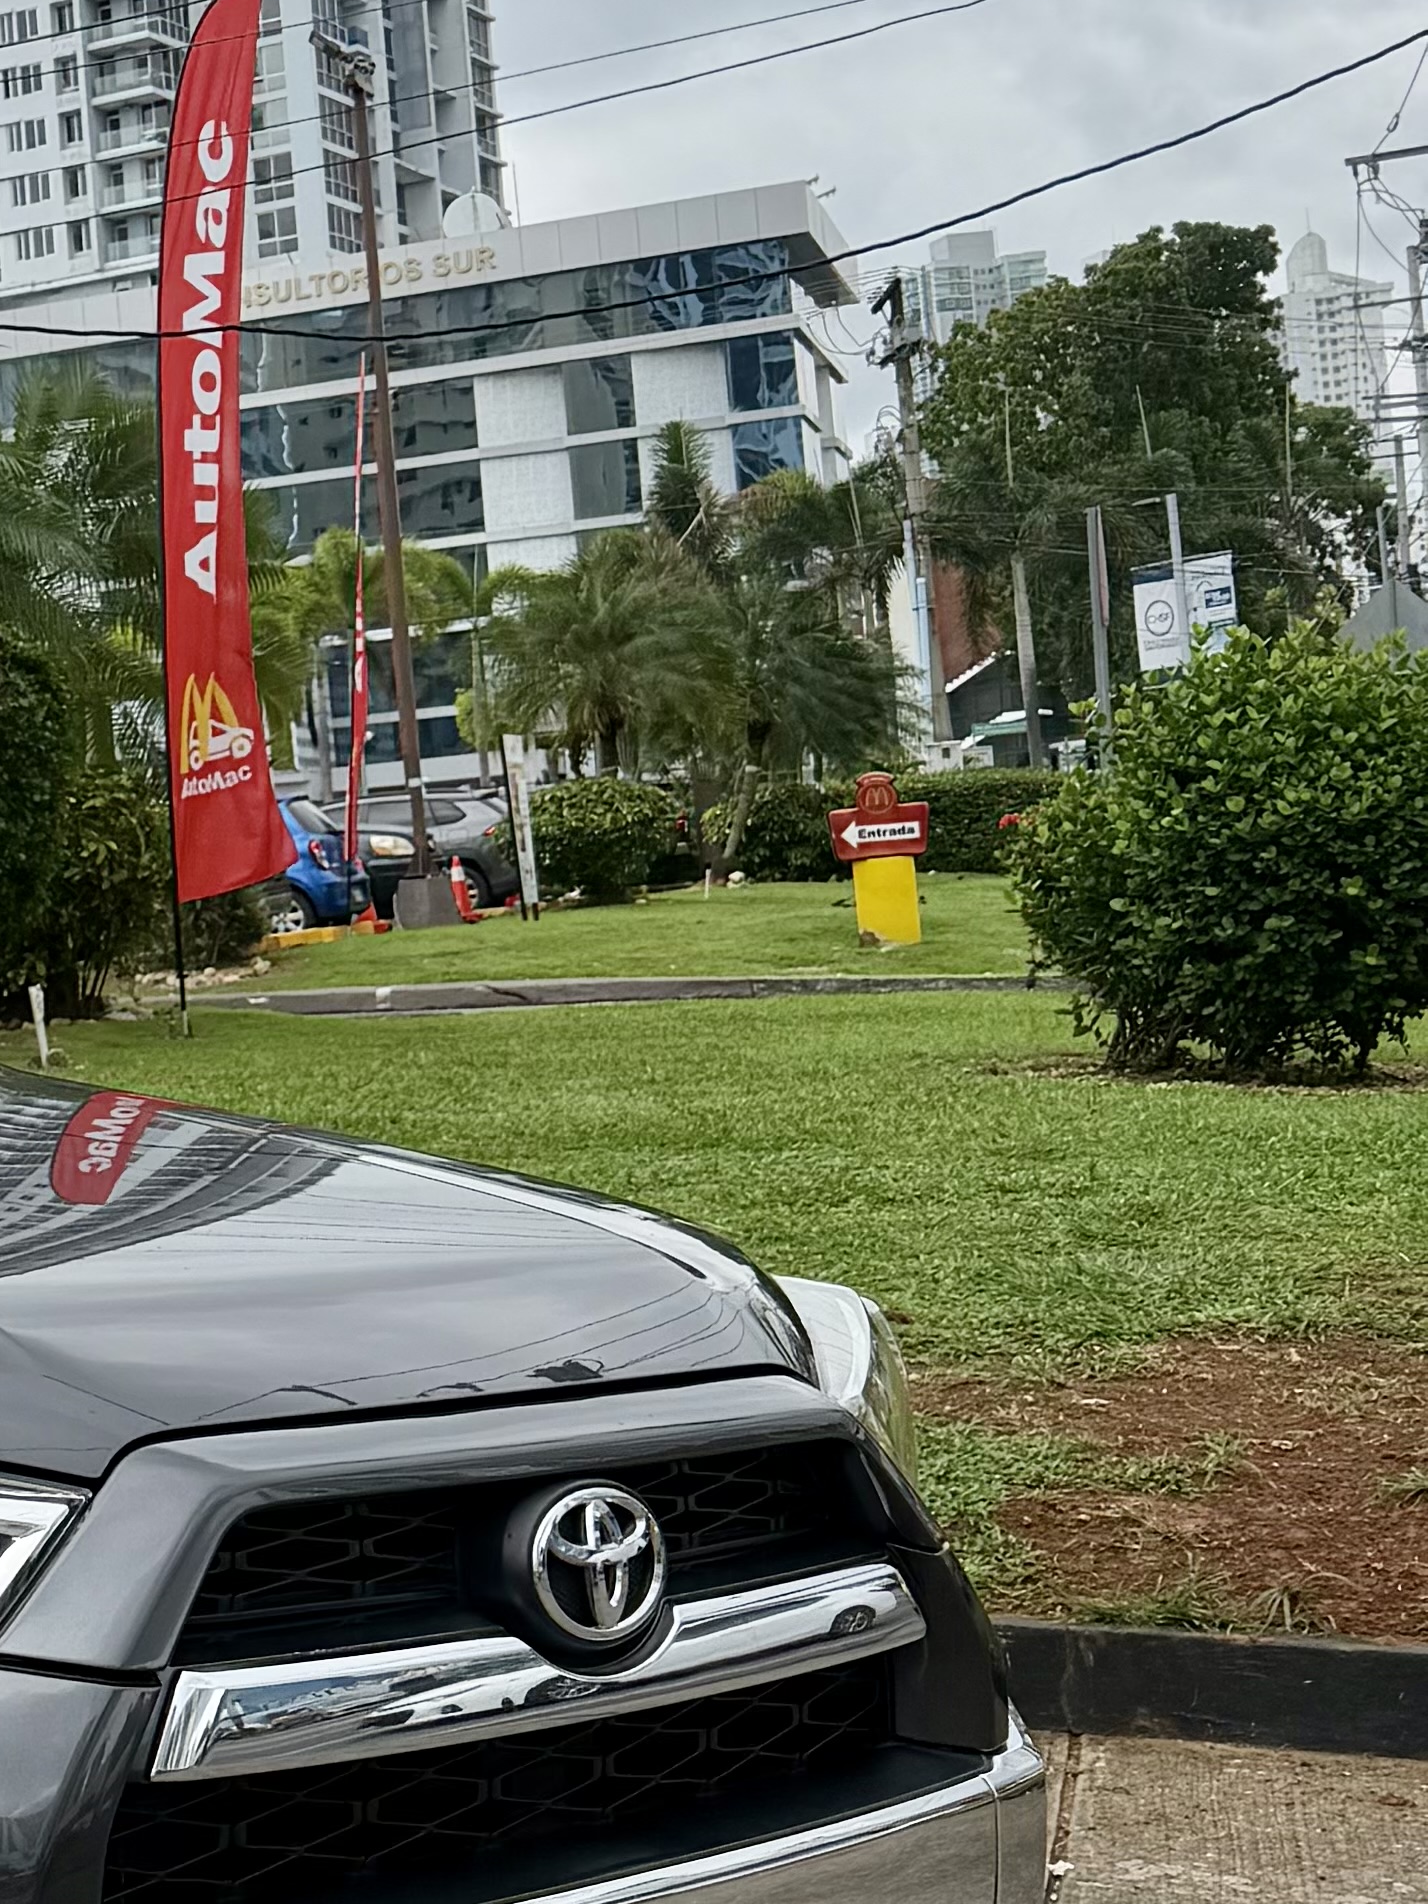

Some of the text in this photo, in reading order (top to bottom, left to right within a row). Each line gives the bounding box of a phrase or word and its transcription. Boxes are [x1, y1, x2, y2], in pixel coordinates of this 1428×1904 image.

[244, 246, 497, 309] SULTOROS SUR
[182, 119, 234, 601] AutoMac
[857, 826, 916, 839] Entrada
